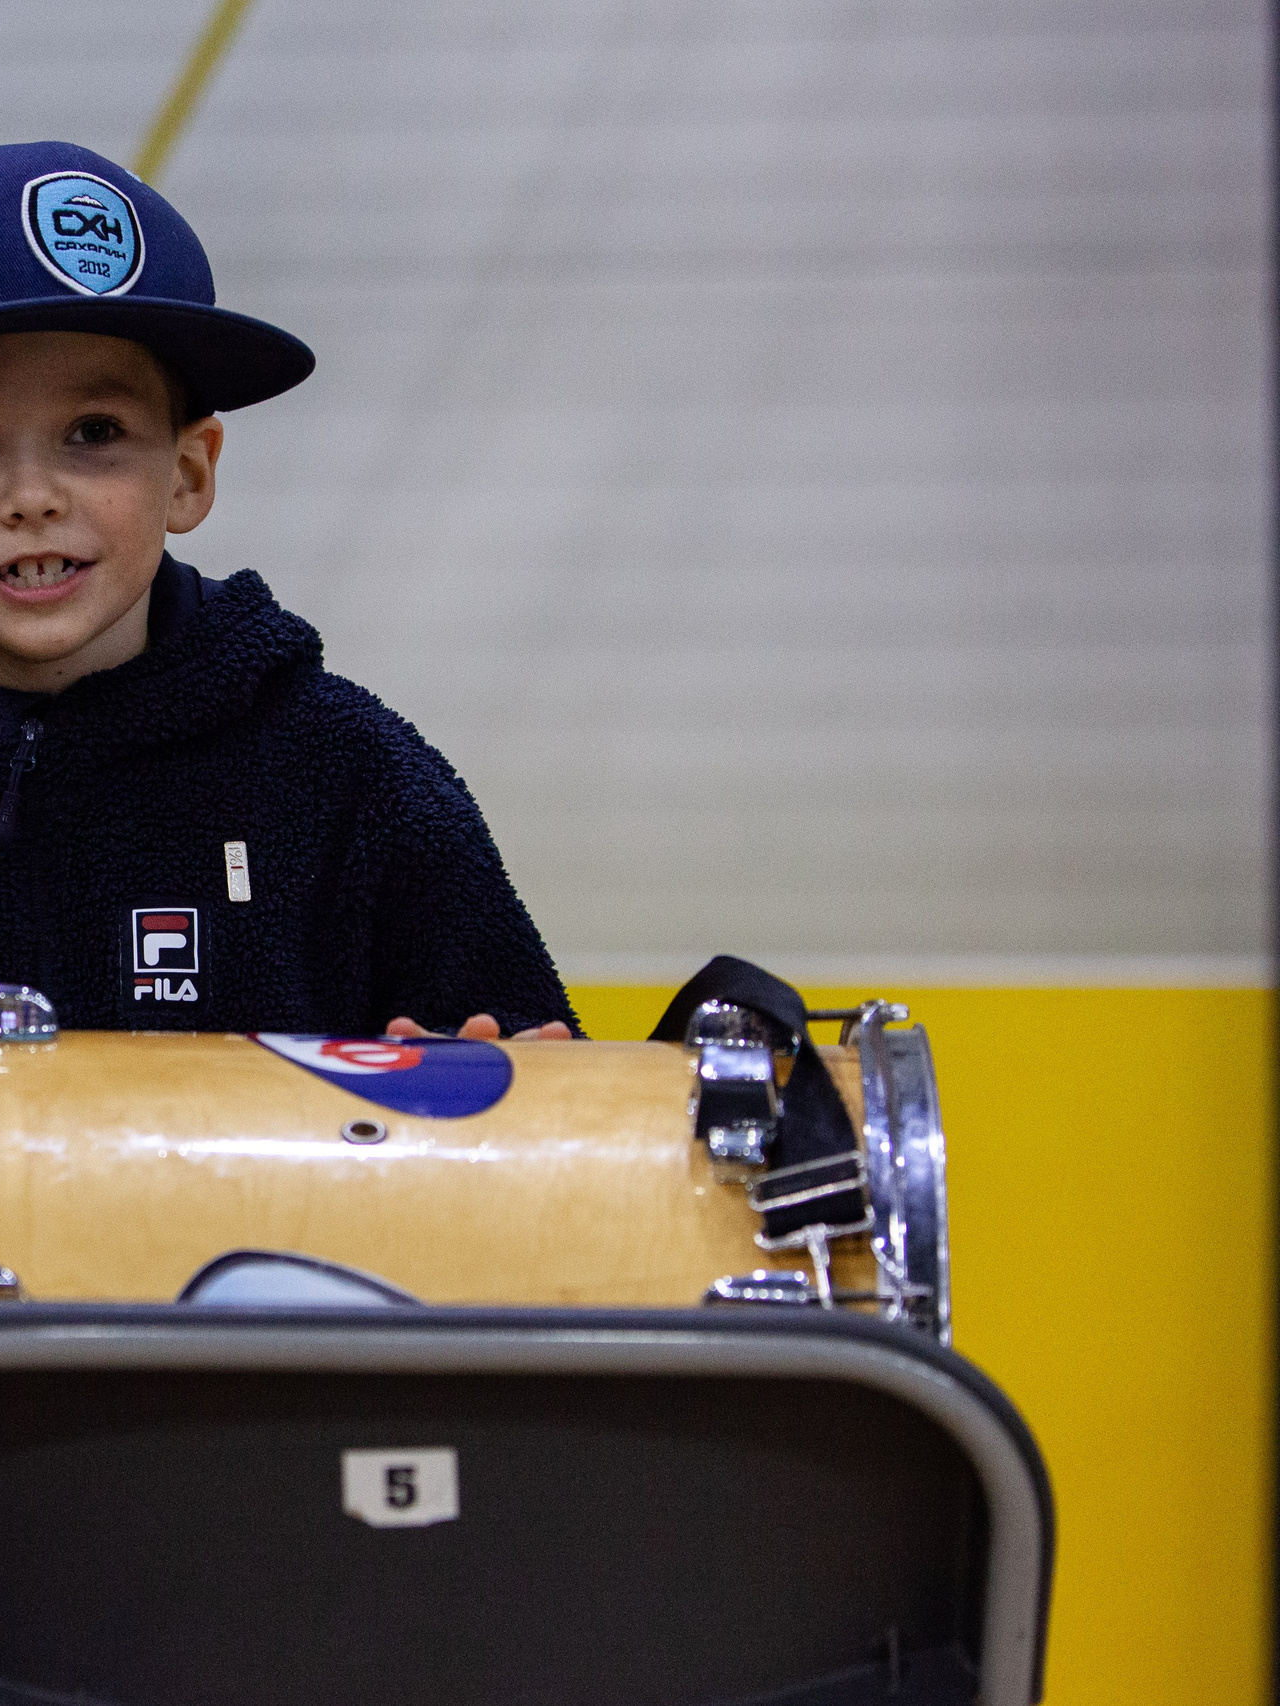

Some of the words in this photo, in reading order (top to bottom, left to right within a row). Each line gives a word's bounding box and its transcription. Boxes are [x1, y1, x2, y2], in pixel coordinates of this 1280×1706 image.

[52, 208, 123, 245] СХН
[78, 259, 111, 278] 2012
[134, 978, 198, 1002] FILA
[385, 1466, 416, 1509] 5
